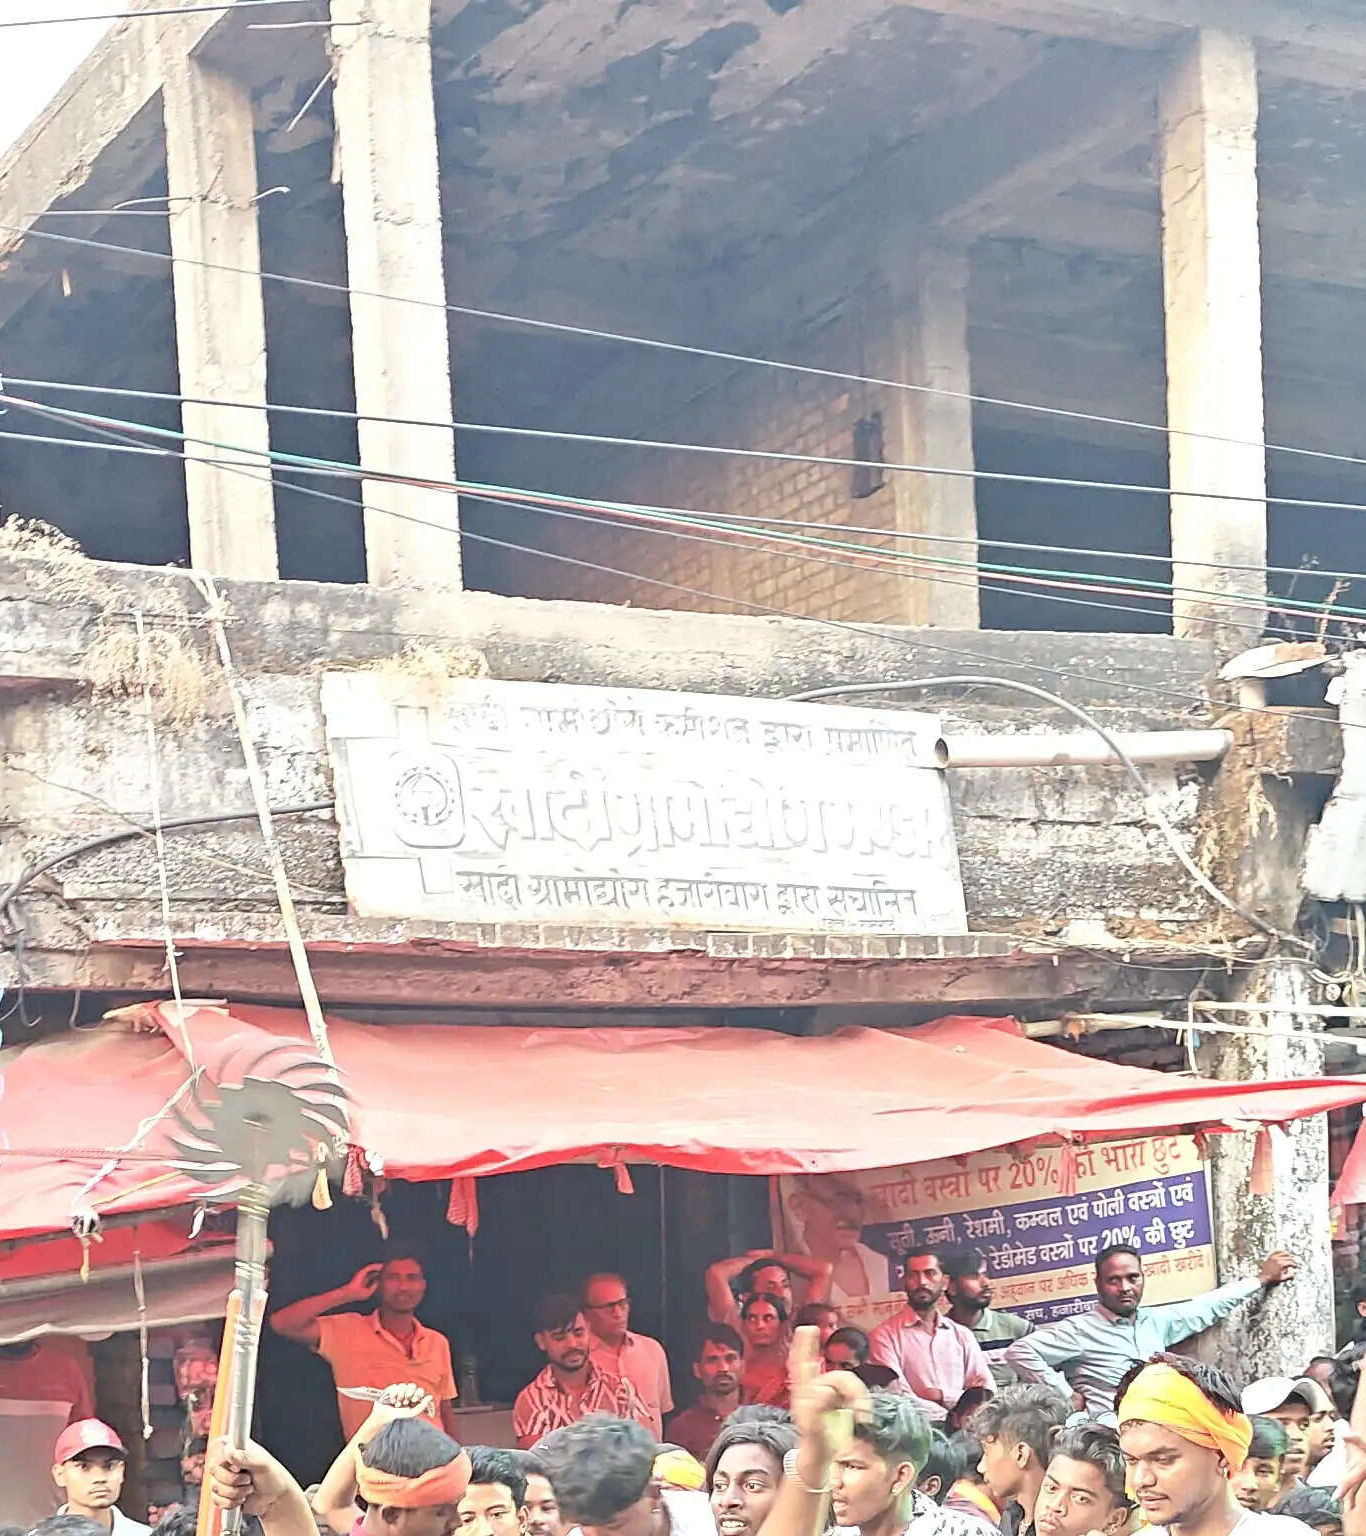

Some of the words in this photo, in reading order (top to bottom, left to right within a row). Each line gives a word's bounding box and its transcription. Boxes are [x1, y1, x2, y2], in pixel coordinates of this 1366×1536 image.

[978, 1164, 1000, 1195] पर
[1010, 1154, 1059, 1191] 20%
[963, 1206, 1012, 1243] रेशमी,
[1065, 1195, 1089, 1226] एवं
[1092, 1186, 1125, 1219] पोली
[1128, 1179, 1167, 1212] वस्त्रों
[1169, 1174, 1195, 1207] एवं
[1039, 1230, 1075, 1262] वस्त्रों
[1077, 1229, 1098, 1259] पर
[1145, 1218, 1167, 1246] की
